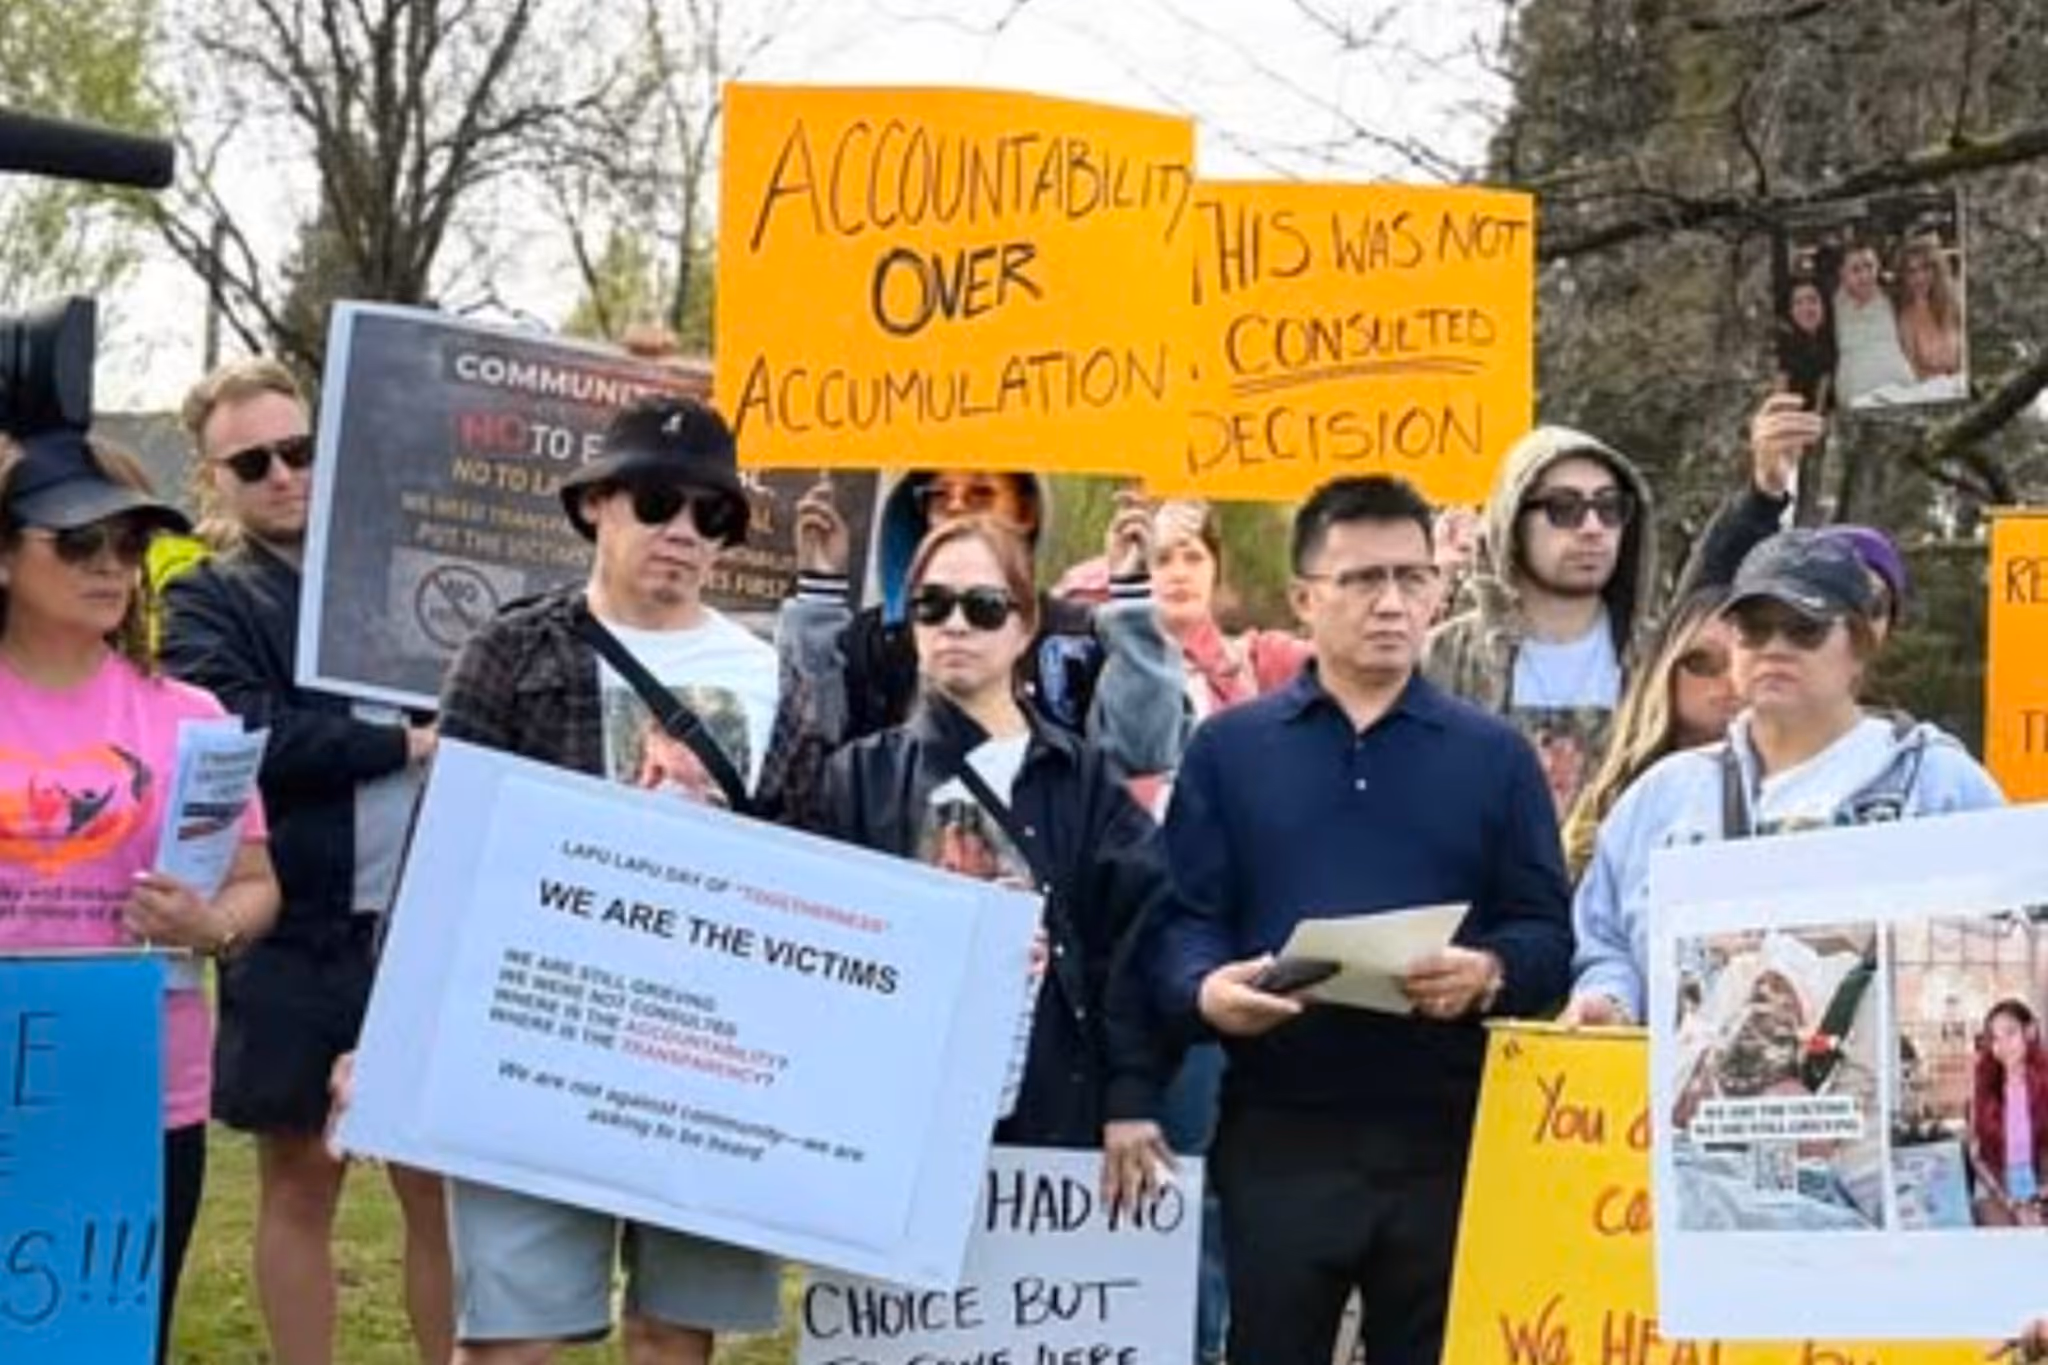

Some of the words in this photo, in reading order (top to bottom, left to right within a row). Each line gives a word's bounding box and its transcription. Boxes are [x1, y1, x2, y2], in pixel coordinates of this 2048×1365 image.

[751, 118, 1194, 253] ACCOUNTABILITY
[1331, 210, 1423, 275] WAS
[1437, 211, 1527, 263] NOT
[872, 242, 1044, 338] OVER
[1224, 308, 1497, 374] CONSULTED
[734, 345, 1167, 438] ACCUMULATION
[458, 413, 529, 451] NO
[530, 423, 575, 461] TO
[1187, 403, 1483, 475] DECISION
[452, 457, 491, 487] NO
[496, 463, 529, 493] TO
[704, 876, 730, 892] OF
[538, 877, 596, 918] WE
[601, 898, 678, 938] ARE
[686, 918, 755, 958] THE
[762, 936, 899, 995] VICTIMS
[499, 967, 527, 986] WE
[531, 974, 585, 999] WERE
[589, 988, 626, 1009] NOT
[503, 948, 532, 967] WE
[537, 955, 575, 975] ARE
[578, 965, 626, 990] STILL
[488, 1006, 555, 1033] WHERE
[558, 1023, 578, 1041] IS
[582, 1027, 616, 1050] THE
[493, 986, 559, 1013] WHERE
[563, 1003, 582, 1021] IS
[586, 1008, 622, 1029] THE
[498, 1059, 530, 1082] We
[534, 1072, 566, 1091] are
[569, 1080, 603, 1100] not
[605, 1088, 678, 1120] against
[833, 1144, 866, 1163] are
[585, 1107, 653, 1139] asking
[655, 1121, 676, 1140] to
[679, 1126, 705, 1147] be
[708, 1133, 766, 1163] heard
[1533, 1070, 1605, 1145] You
[986, 1168, 1092, 1236] HAD
[803, 1281, 984, 1341] CHOICE
[1012, 1276, 1140, 1329] BUT
